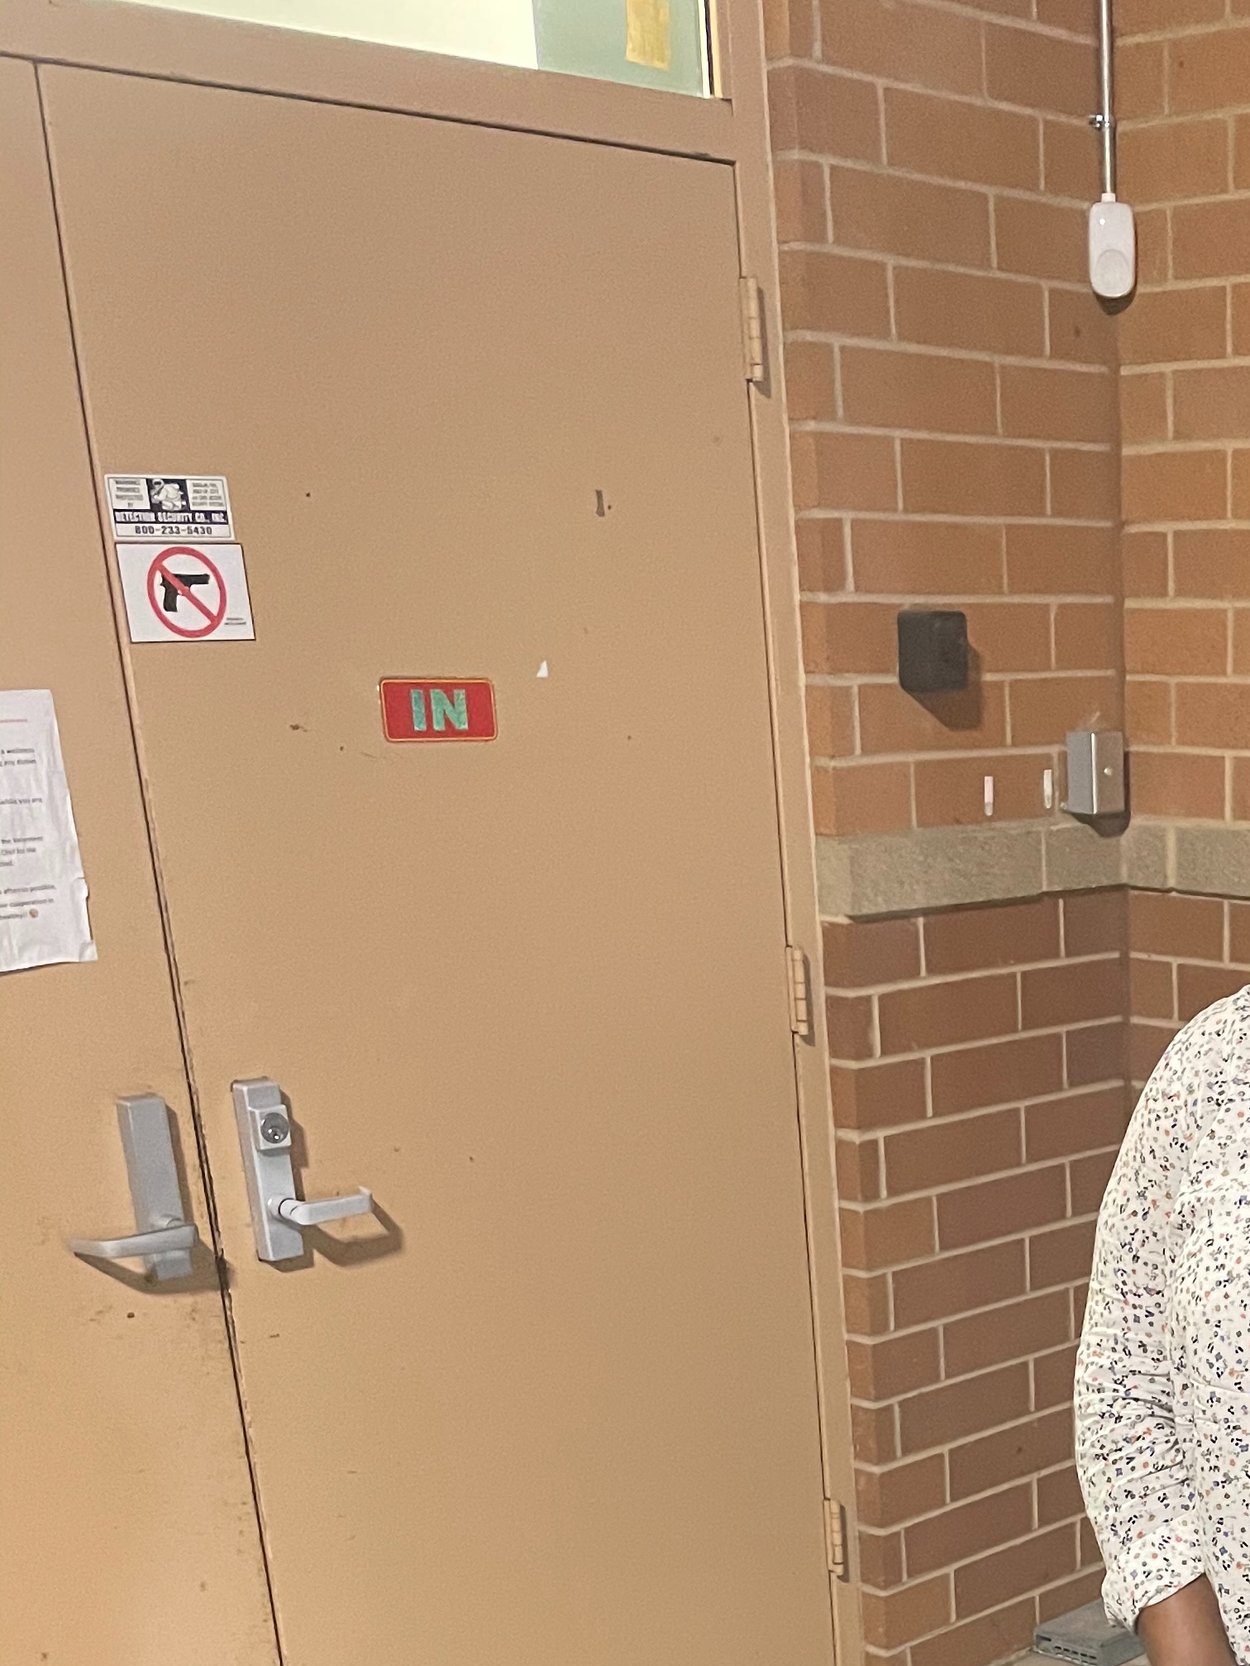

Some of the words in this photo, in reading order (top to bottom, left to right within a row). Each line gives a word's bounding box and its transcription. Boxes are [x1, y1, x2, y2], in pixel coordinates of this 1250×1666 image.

[157, 512, 193, 523] SECURITY
[135, 525, 213, 536] 800-233-5430
[410, 688, 469, 732] IN
